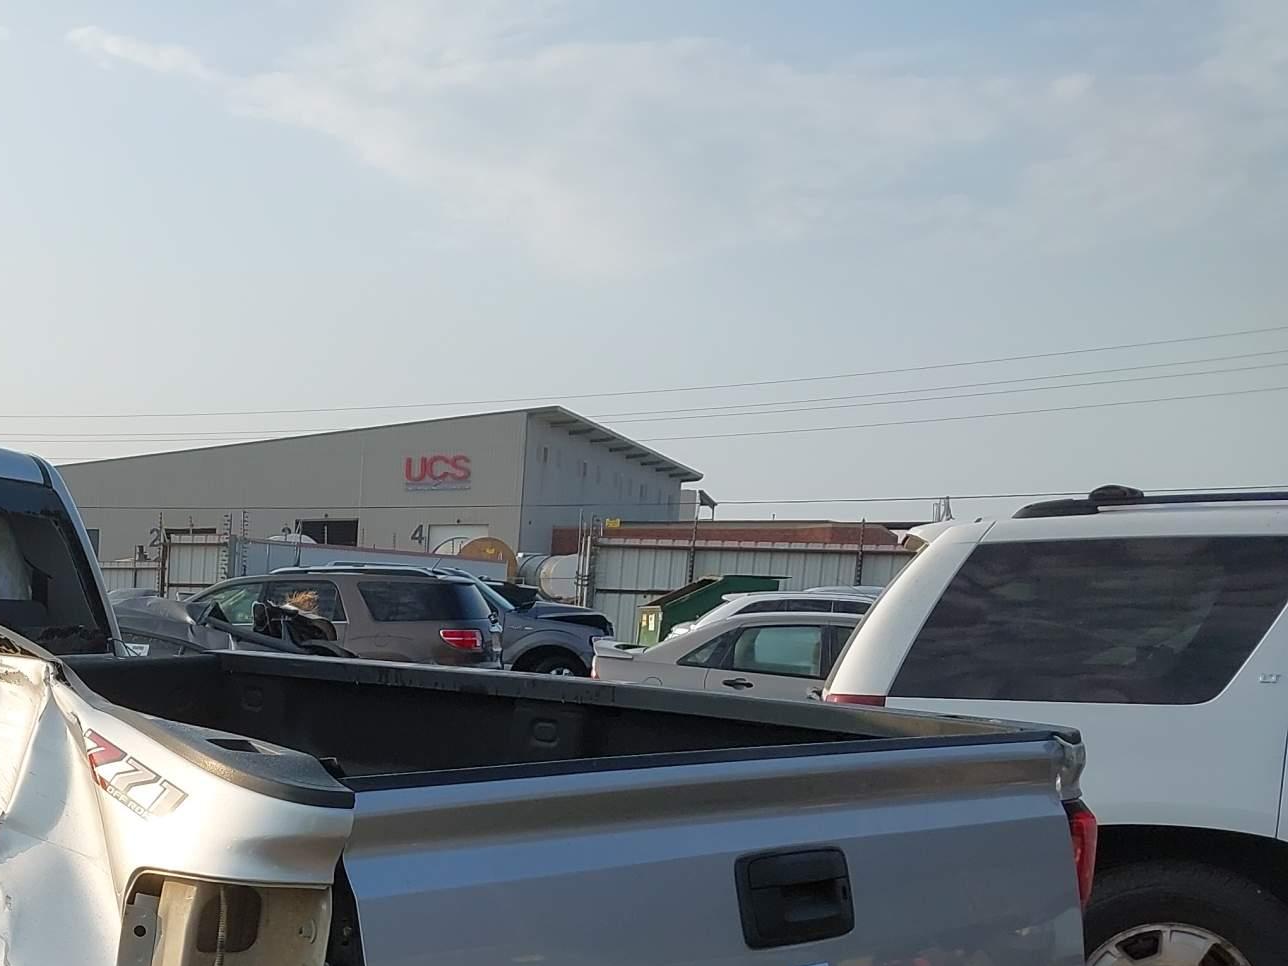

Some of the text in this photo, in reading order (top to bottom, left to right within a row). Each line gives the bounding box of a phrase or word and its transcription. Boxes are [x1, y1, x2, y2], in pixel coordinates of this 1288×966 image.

[405, 455, 471, 481] UCS
[149, 528, 161, 547] 2
[411, 525, 425, 544] 4
